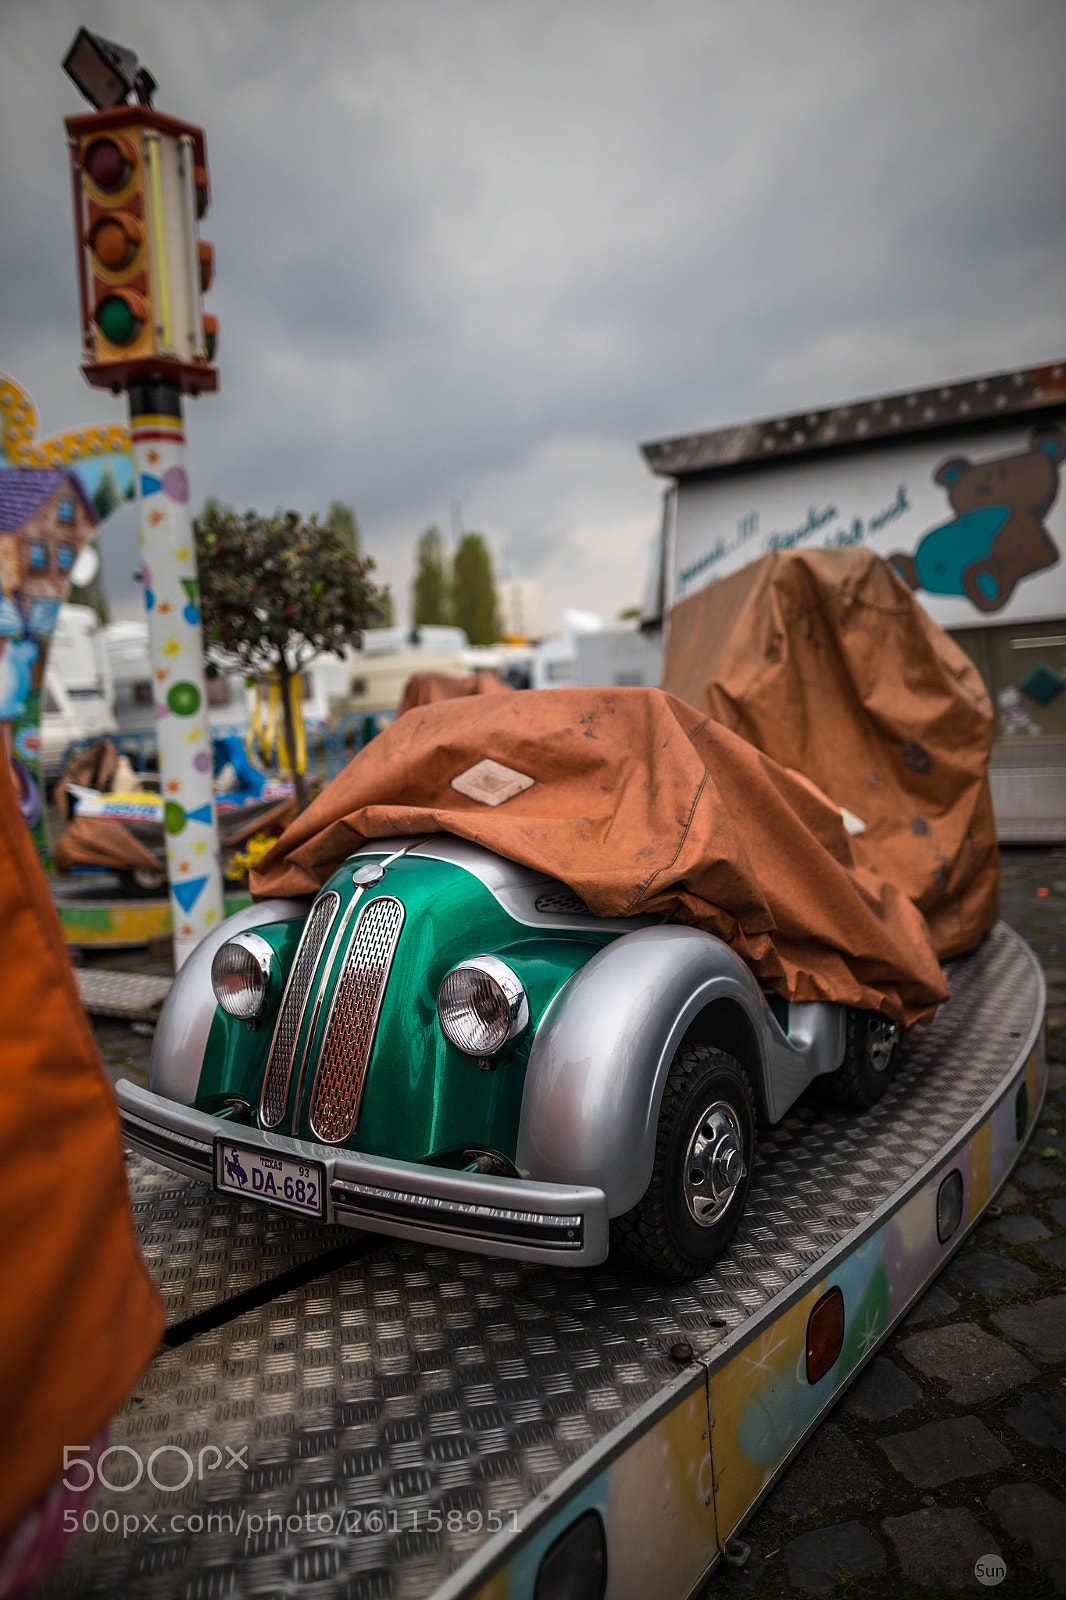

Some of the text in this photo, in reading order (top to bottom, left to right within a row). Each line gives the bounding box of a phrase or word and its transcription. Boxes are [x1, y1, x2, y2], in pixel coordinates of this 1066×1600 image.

[260, 1157, 282, 1171] TEXAS
[298, 1167, 310, 1178] 93
[251, 1167, 318, 1207] DA-682
